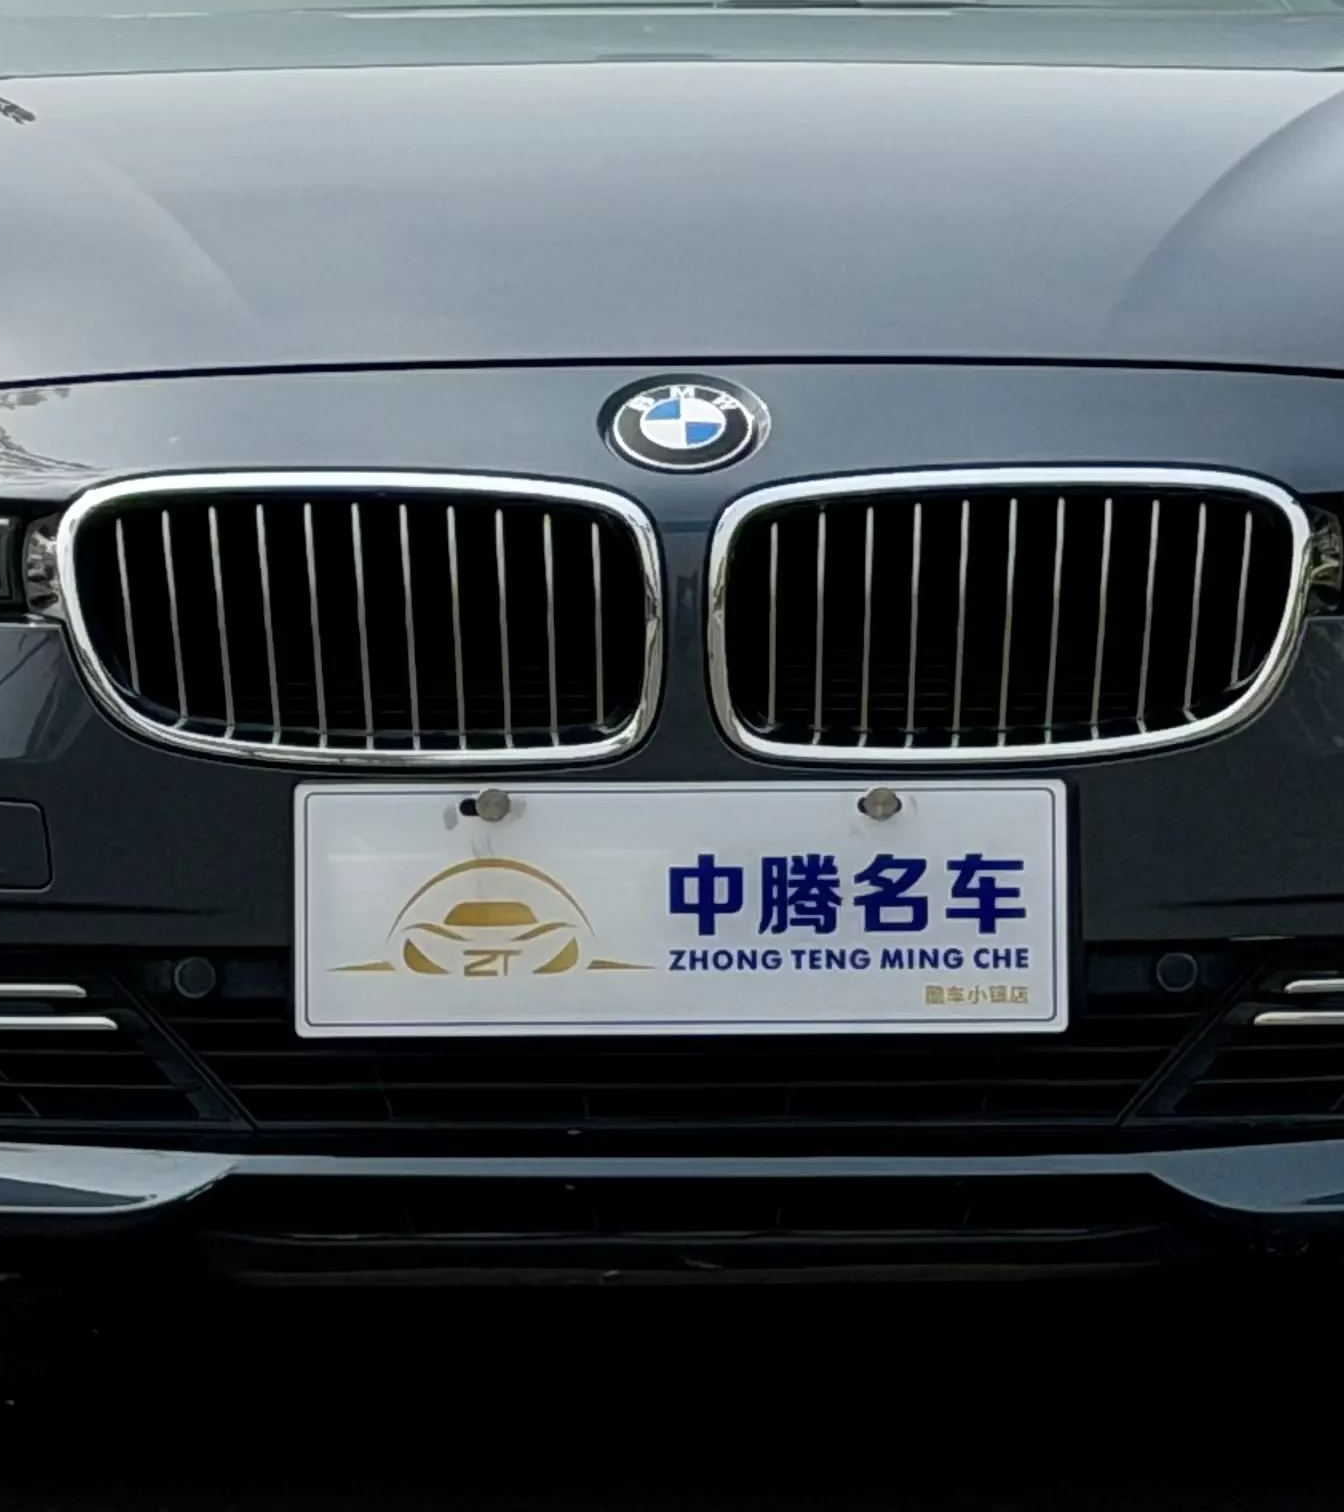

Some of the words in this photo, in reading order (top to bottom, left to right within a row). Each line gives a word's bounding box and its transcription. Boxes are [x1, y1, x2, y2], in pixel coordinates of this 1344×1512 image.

[668, 853, 1026, 936] 中腾名车
[669, 948, 783, 971] ZHONG
[791, 948, 871, 970] TENG
[879, 947, 964, 970] MING
[973, 947, 1029, 969] CHE
